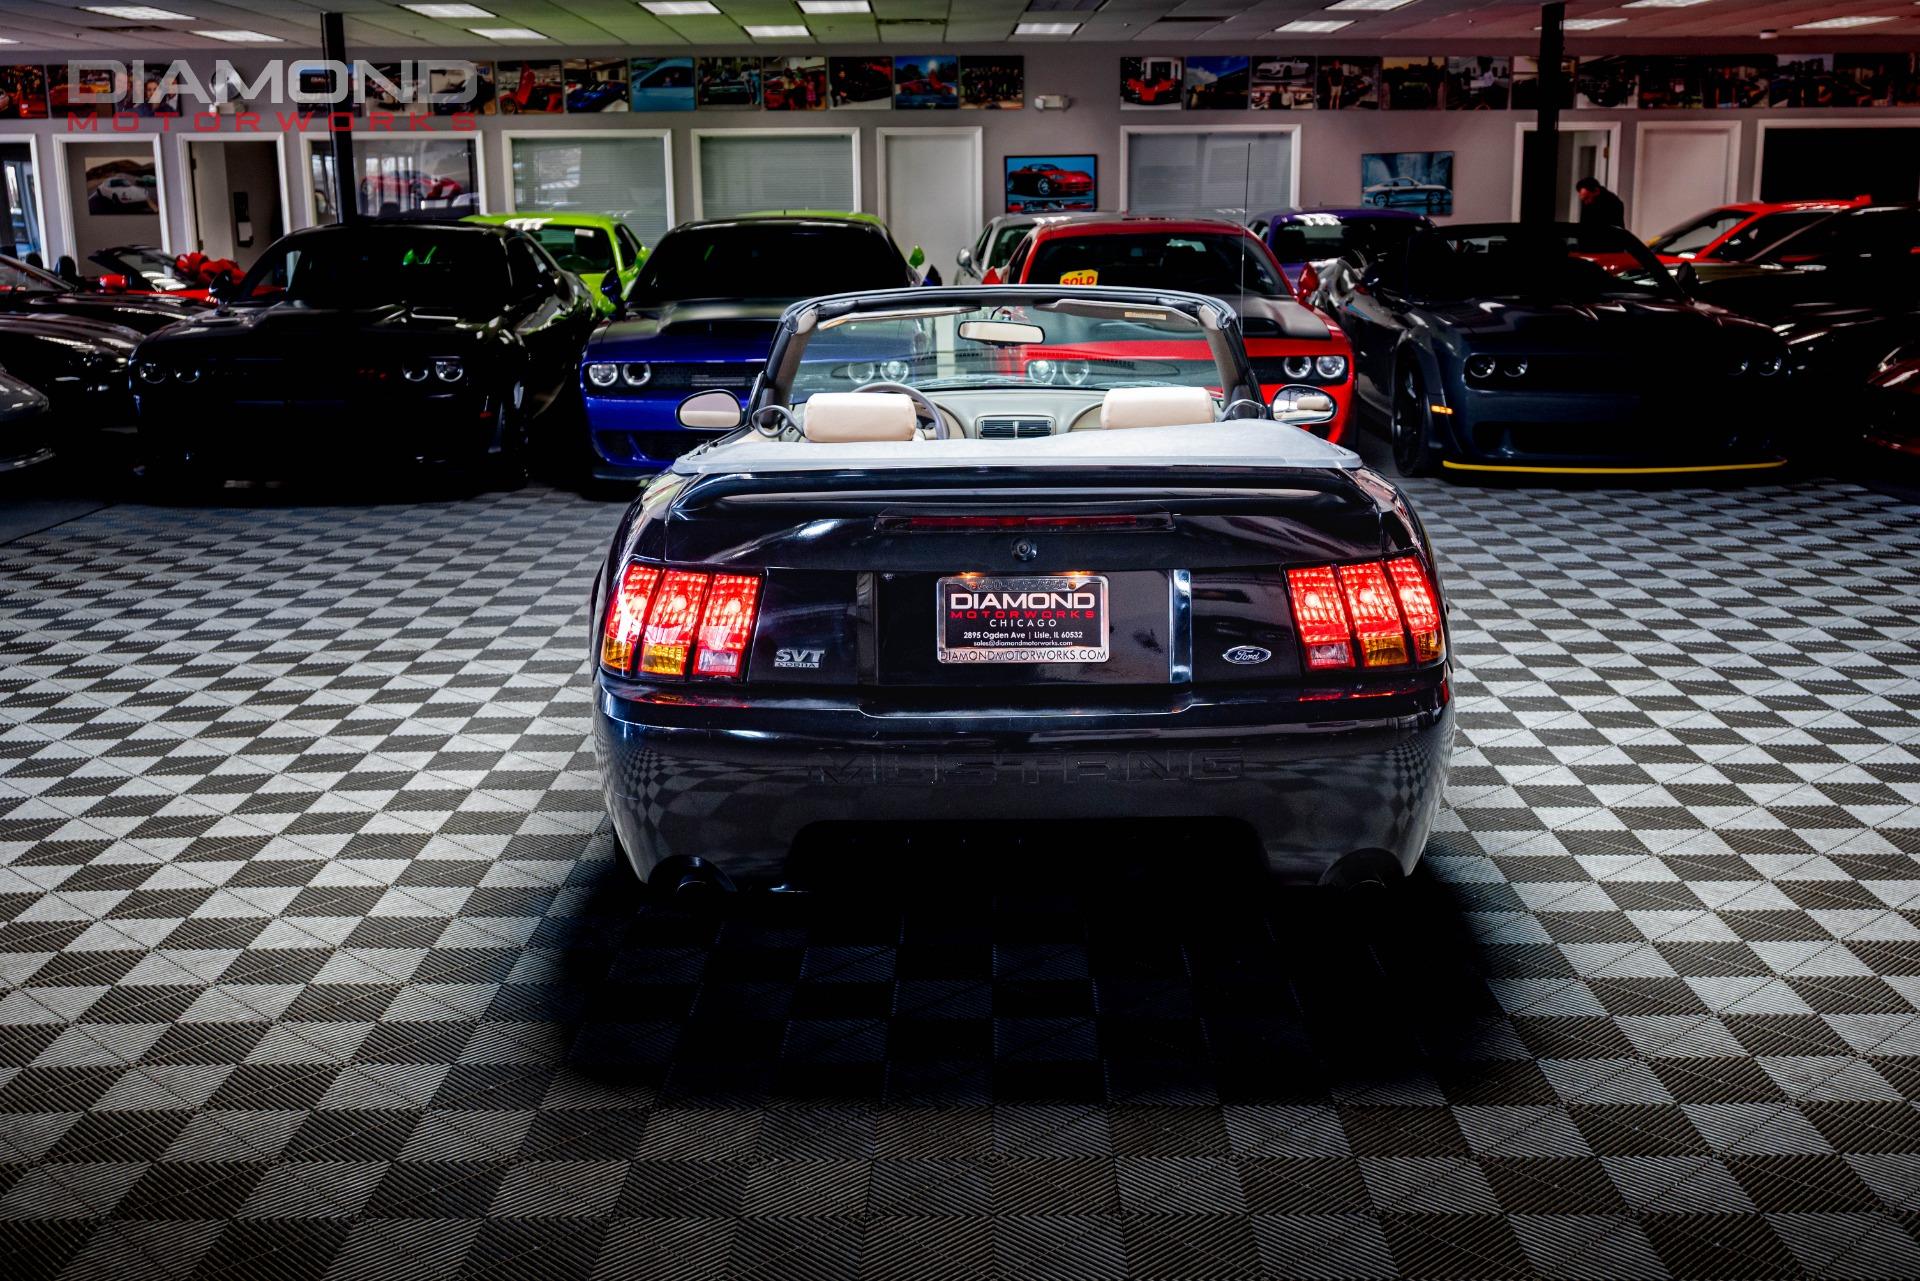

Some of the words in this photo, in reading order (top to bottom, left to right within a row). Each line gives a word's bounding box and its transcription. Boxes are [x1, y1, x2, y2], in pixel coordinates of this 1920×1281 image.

[1062, 275, 1095, 285] SOLD
[950, 593, 1096, 609] DIAMOND
[950, 610, 1096, 619] MOTORWORKS
[989, 619, 1057, 627] CHICAGO
[983, 632, 1010, 640] Ogden
[1034, 632, 1052, 640] Lisle,
[775, 648, 825, 662] SVT
[941, 650, 1107, 661] DIAMONDMOTORWORKS.COM
[1234, 649, 1261, 661] Ford
[807, 748, 1244, 785] MUSTANG
